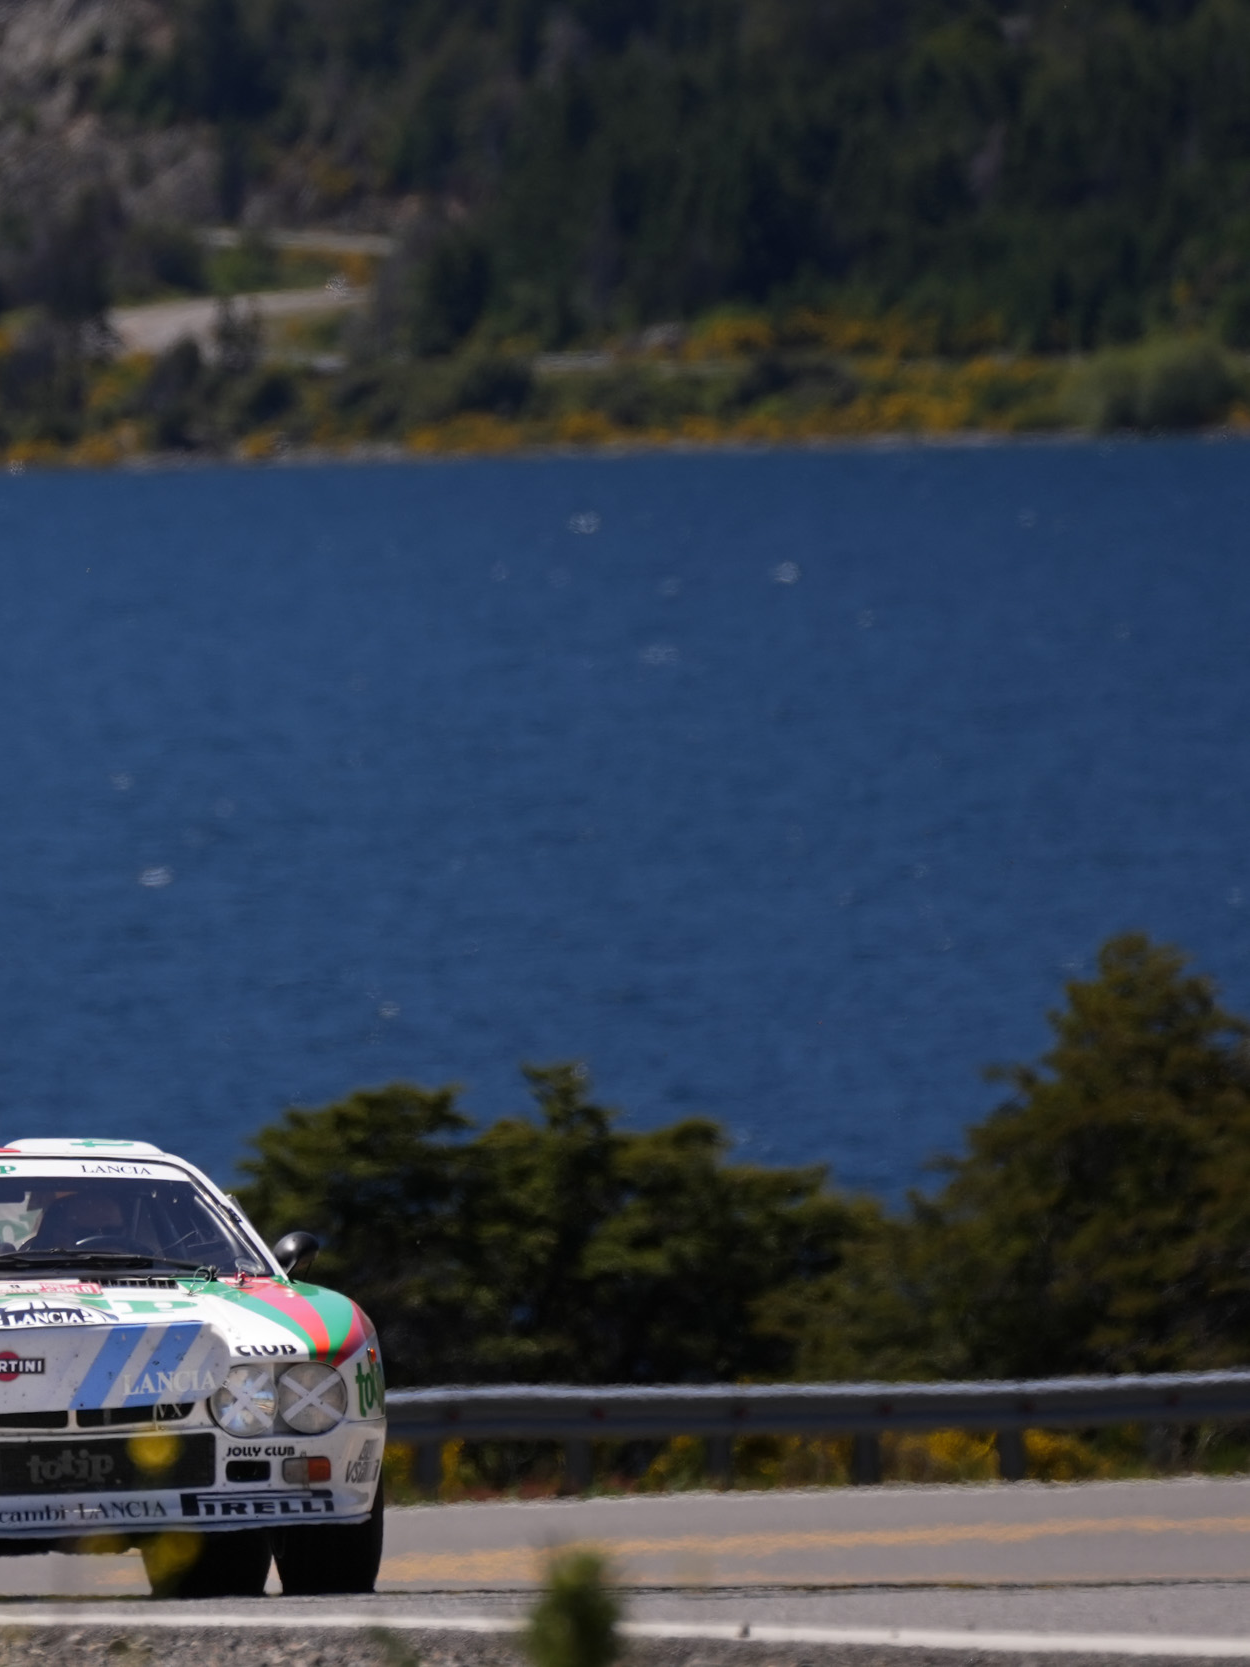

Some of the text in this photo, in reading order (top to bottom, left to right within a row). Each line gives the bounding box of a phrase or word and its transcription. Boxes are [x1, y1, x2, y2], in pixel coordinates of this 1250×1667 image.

[81, 1164, 152, 1175] LANCIA
[6, 1311, 83, 1327] LANCIA
[234, 1344, 298, 1357] CLUB
[122, 1368, 217, 1396] LANCIA
[226, 1446, 295, 1458] JOLLY CLUB
[27, 1449, 115, 1484] totip
[78, 1500, 168, 1521] LANCIA
[180, 1489, 334, 1516] PIRELLI
